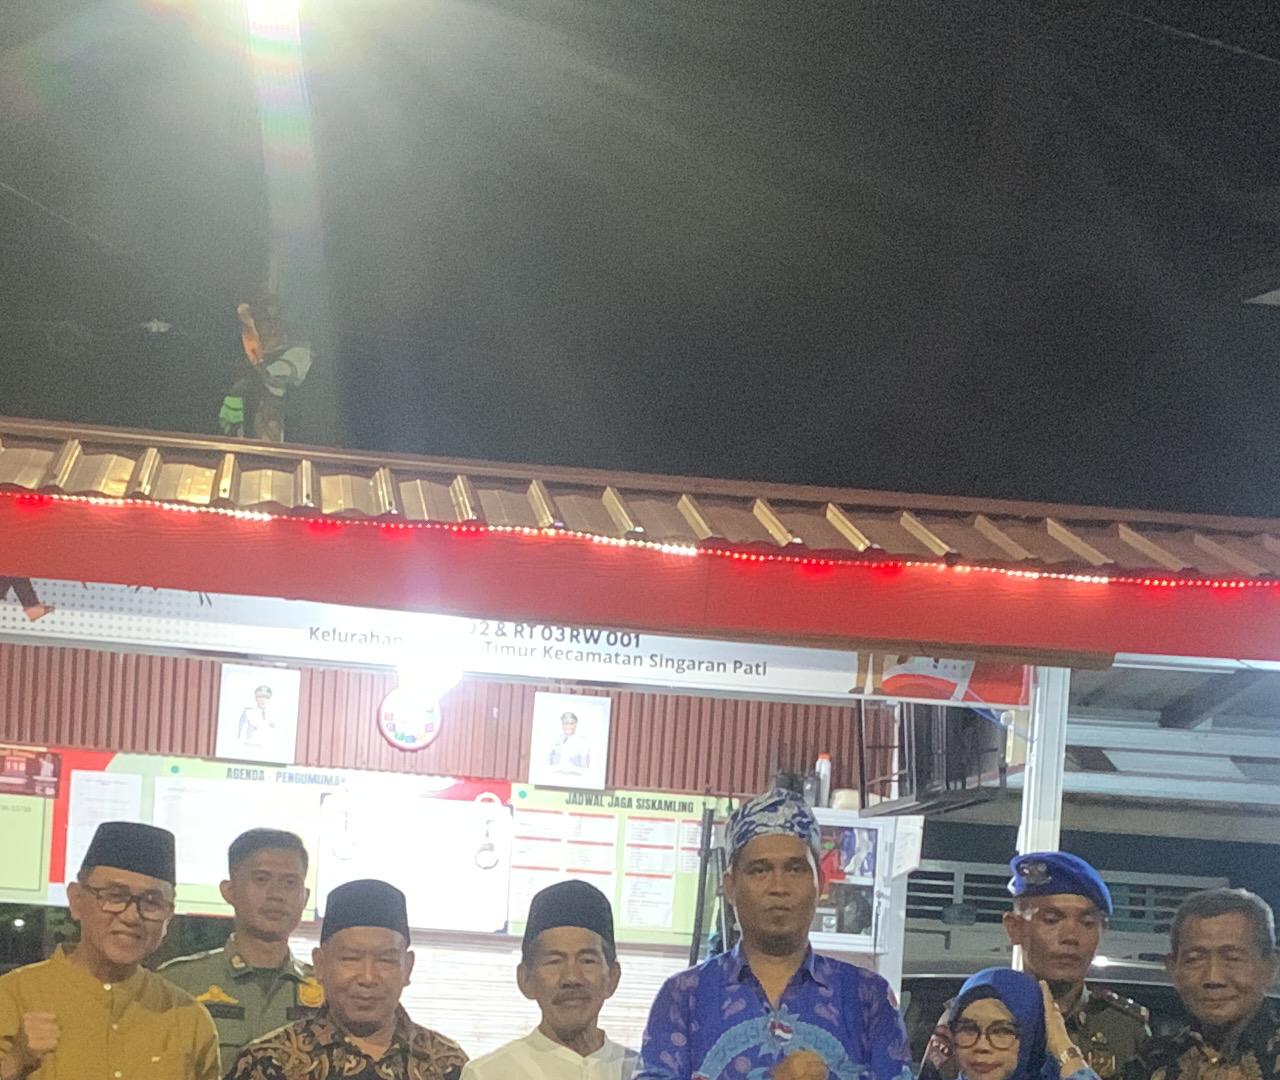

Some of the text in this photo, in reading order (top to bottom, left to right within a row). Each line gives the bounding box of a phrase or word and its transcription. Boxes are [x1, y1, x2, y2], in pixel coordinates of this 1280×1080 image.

[494, 622, 508, 638] &
[514, 623, 536, 640] RT
[570, 628, 601, 645] RW
[606, 631, 640, 649] 001
[484, 641, 537, 658] Timur
[543, 645, 643, 667] Kecamatan
[649, 653, 727, 674] Singaran
[733, 659, 767, 676] Pati
[226, 767, 265, 782] AGENDA
[565, 791, 694, 814] JADWAL JAGA SISKAMLING
